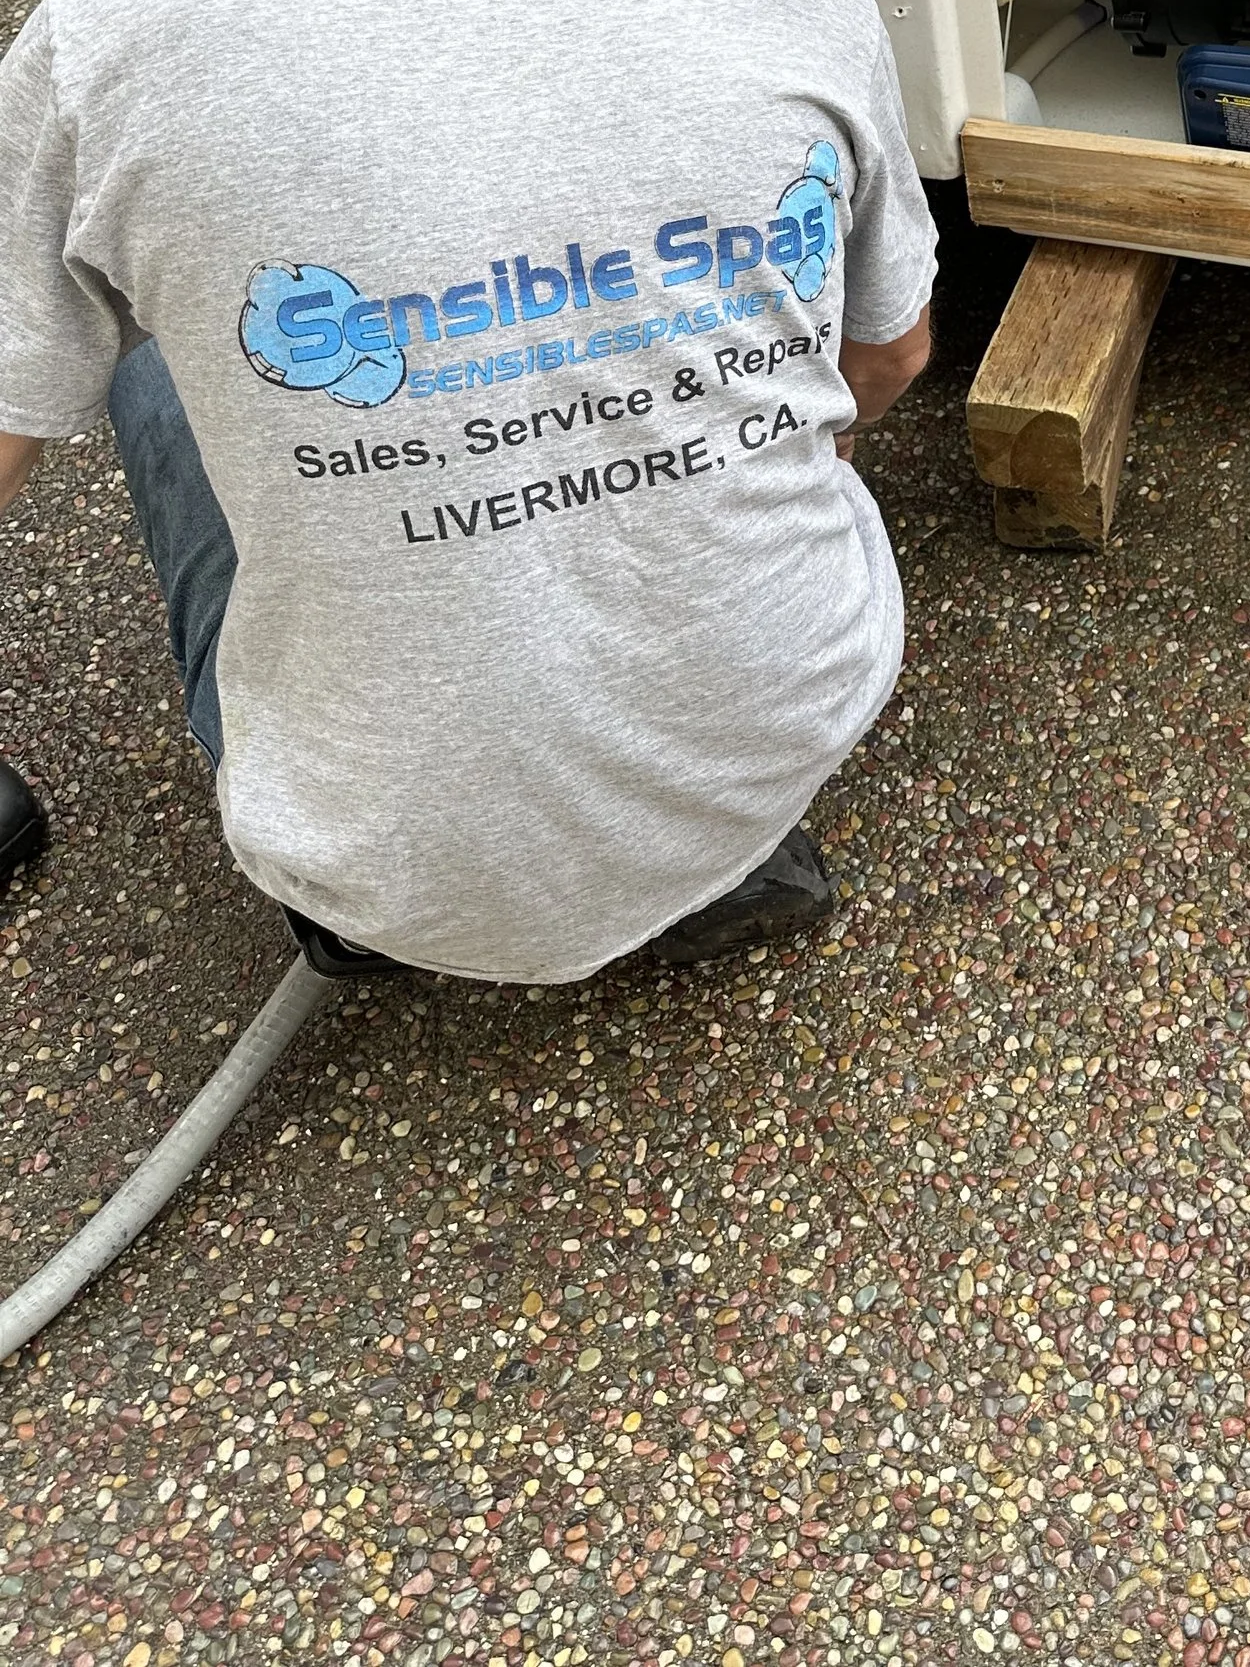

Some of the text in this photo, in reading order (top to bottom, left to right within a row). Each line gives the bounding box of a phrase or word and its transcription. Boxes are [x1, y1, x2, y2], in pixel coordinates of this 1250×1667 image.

[277, 205, 827, 363] Sensible Spas
[407, 290, 788, 399] SENSIBLESPAS.NET
[293, 322, 832, 479] Sales, Service & Repais
[401, 401, 809, 544] LIVERMORE, CA.
